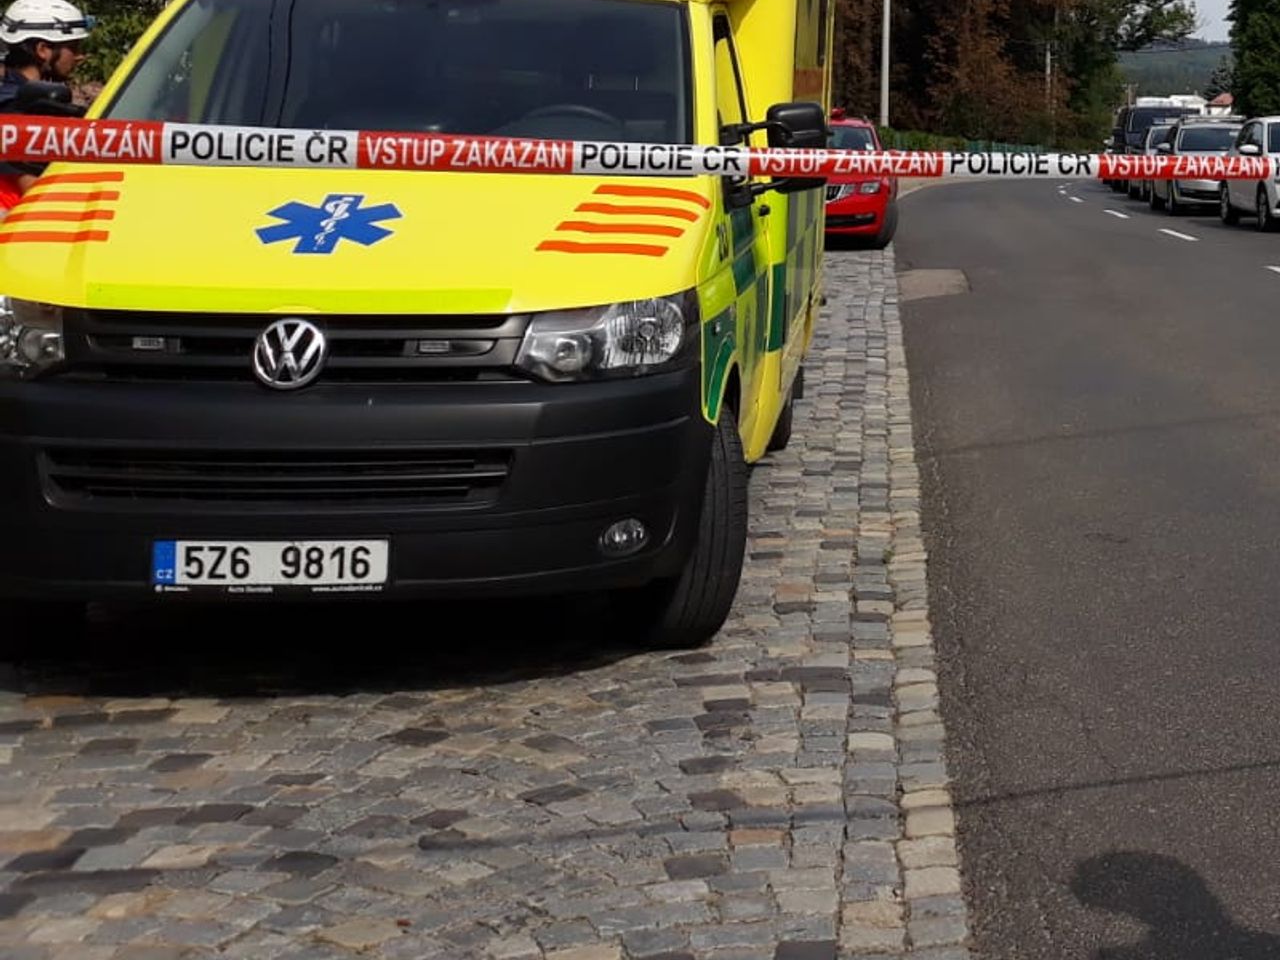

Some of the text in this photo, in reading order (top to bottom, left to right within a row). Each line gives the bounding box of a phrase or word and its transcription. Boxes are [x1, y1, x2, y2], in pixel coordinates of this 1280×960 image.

[24, 122, 155, 159] ZAKÁZÁN
[171, 131, 296, 163] POLICIE
[305, 131, 348, 165] ČR
[366, 136, 446, 166] VSTUP
[580, 143, 694, 171] POLICIE
[757, 148, 830, 173] VSTUP
[950, 152, 1050, 175] POLICIE
[1105, 154, 1168, 176] VSTUP
[156, 569, 173, 580] CZ
[184, 545, 371, 580] 5Z6 9816
